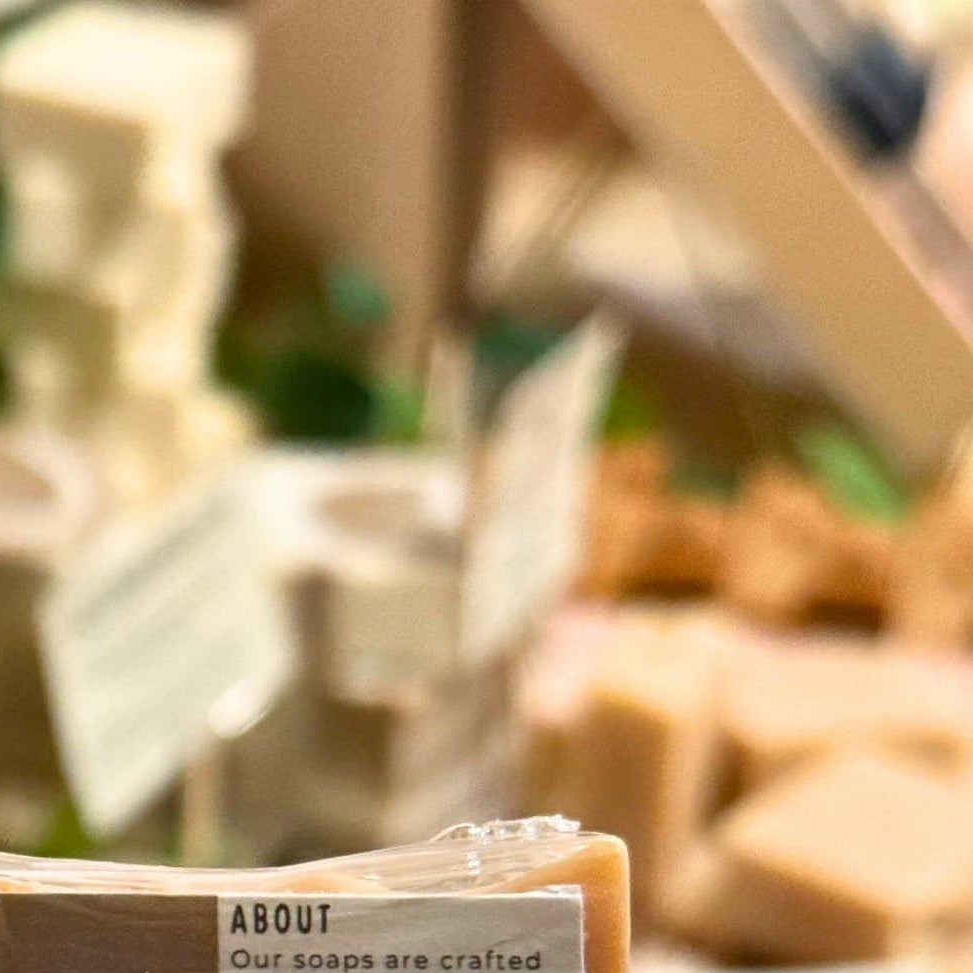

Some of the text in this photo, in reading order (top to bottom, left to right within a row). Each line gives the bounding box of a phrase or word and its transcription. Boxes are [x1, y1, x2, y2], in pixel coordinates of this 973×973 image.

[231, 904, 331, 933] ABOUT
[231, 949, 541, 972] Our soaps are crafted
